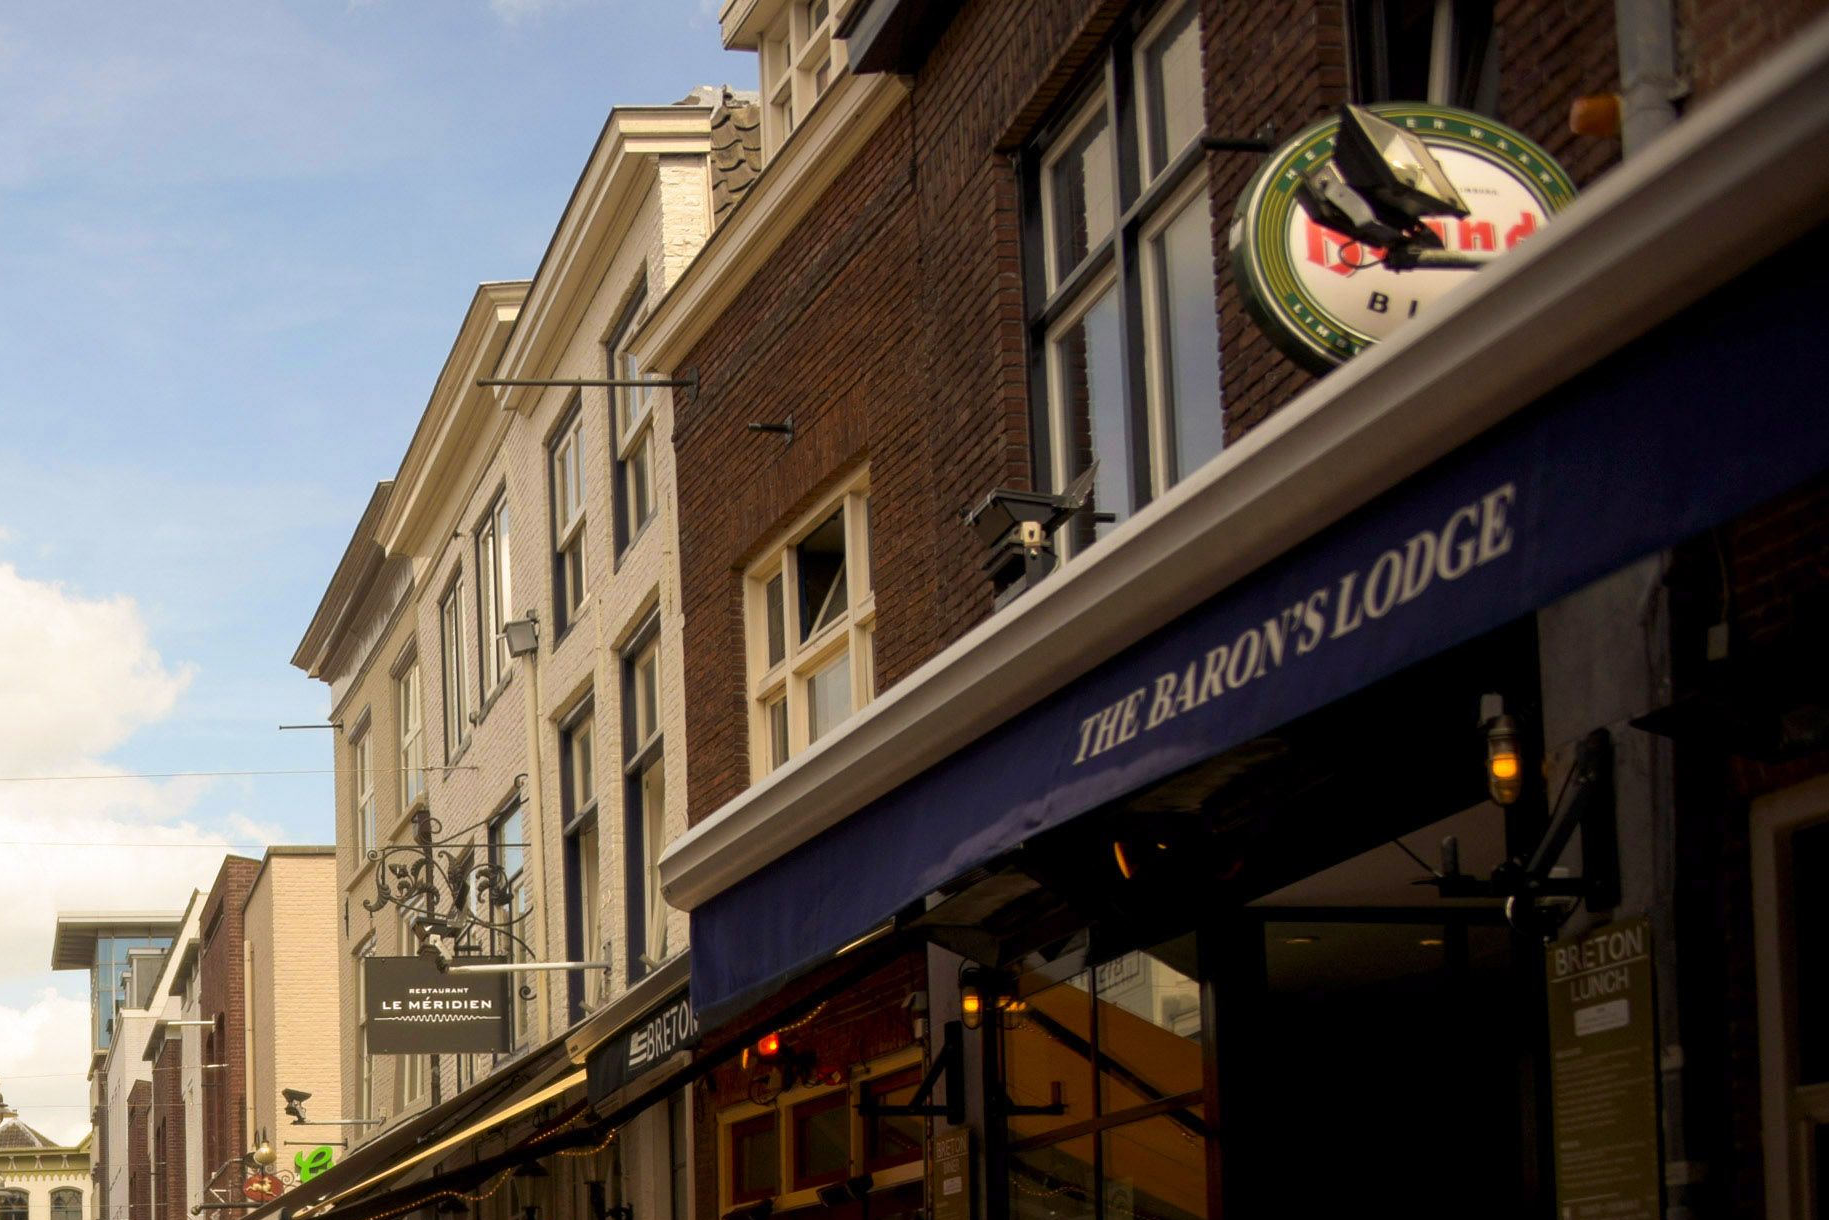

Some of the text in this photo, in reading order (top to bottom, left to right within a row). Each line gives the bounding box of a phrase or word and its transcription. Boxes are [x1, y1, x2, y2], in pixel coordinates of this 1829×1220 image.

[1367, 291, 1419, 319] BI
[1072, 482, 1517, 767] THE BARON'S LODGE
[1555, 926, 1644, 976] BRETON
[1569, 967, 1630, 1002] LUNCH
[382, 996, 492, 1010] LE MÉRIDIEN
[936, 1134, 967, 1159] BRETON
